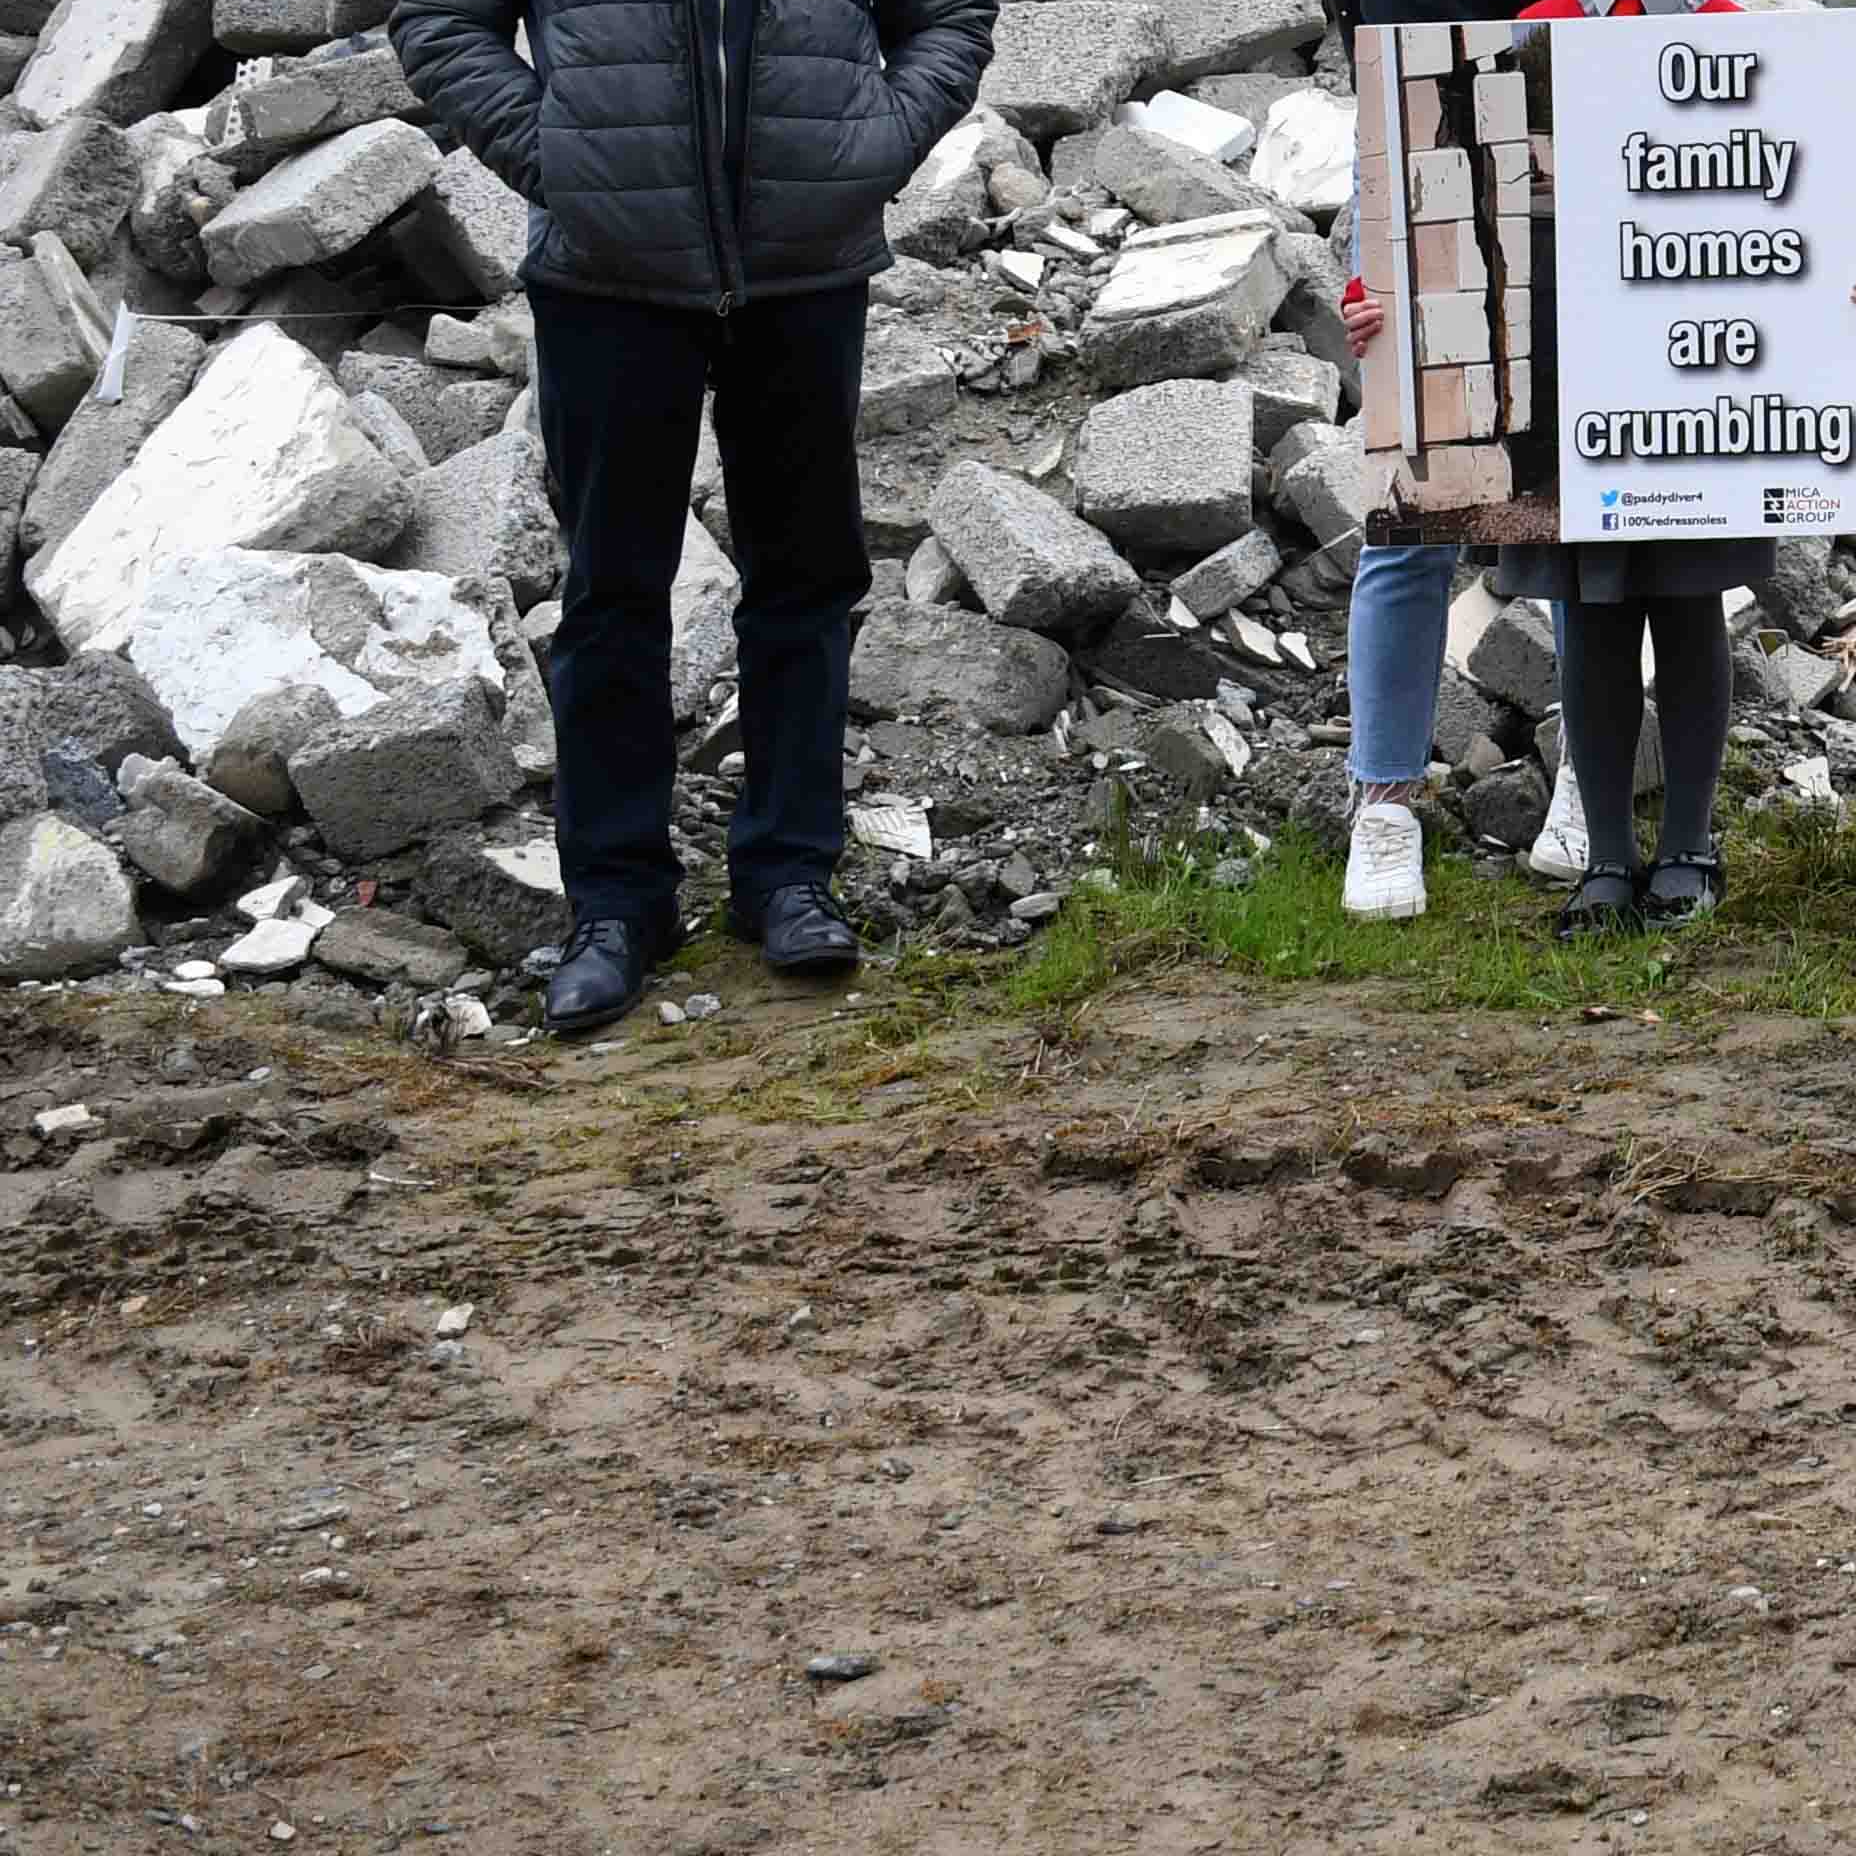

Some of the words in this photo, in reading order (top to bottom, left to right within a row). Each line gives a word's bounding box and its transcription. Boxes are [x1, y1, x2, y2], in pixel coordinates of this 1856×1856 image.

[1658, 43, 1758, 102] Our
[1622, 130, 1796, 200] family
[1619, 222, 1803, 280] homes
[1667, 318, 1758, 368] are
[1575, 395, 1854, 465] crumbling
[1621, 491, 1703, 506] @paddydiver4
[1785, 487, 1822, 499] MICA
[1785, 498, 1841, 511] ACTION
[1622, 514, 1728, 528] 100%redressnoless
[1785, 511, 1836, 524] GROUP
